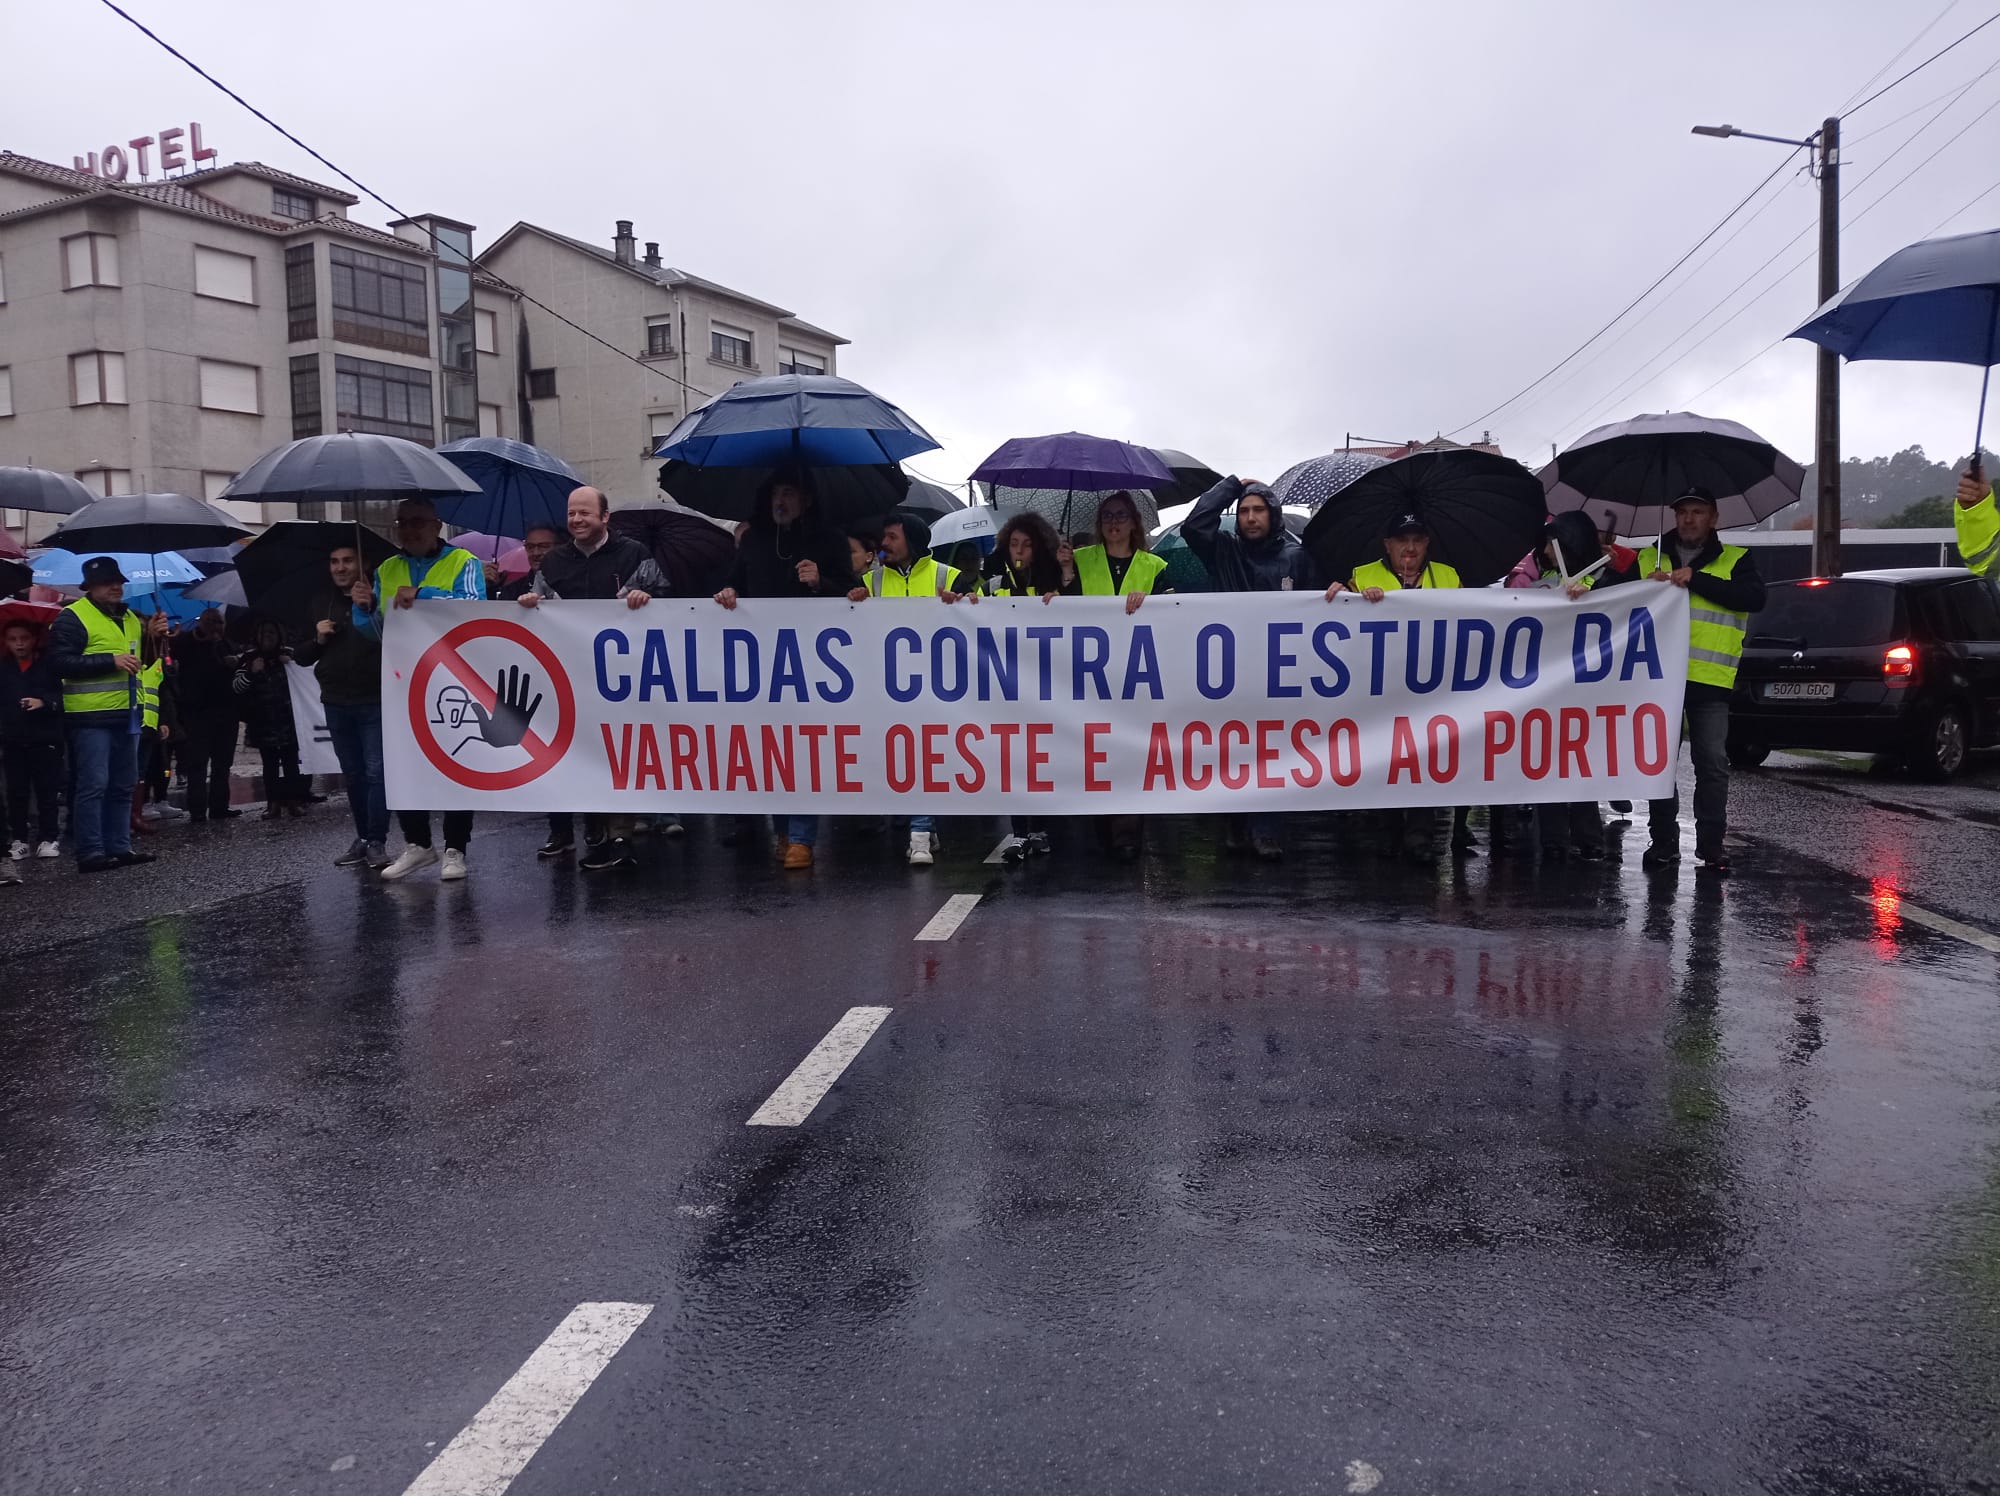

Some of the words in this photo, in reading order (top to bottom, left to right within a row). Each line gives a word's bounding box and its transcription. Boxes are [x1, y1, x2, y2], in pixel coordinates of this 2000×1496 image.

[74, 122, 217, 180] HOTEL
[593, 628, 855, 703] CALDAS
[884, 625, 1164, 703] CONTRA
[1196, 623, 1236, 700] O
[1267, 616, 1543, 698] ESTUDO
[1571, 607, 1664, 684] DA
[1773, 684, 1801, 695] 5070
[1807, 684, 1830, 696] GDC
[601, 723, 864, 793] VARIANTE
[885, 723, 1054, 793] OESTE
[1084, 722, 1112, 792] E
[1143, 717, 1361, 791] ACCESO
[1388, 715, 1459, 785] AO
[1484, 703, 1668, 781] PORTO
